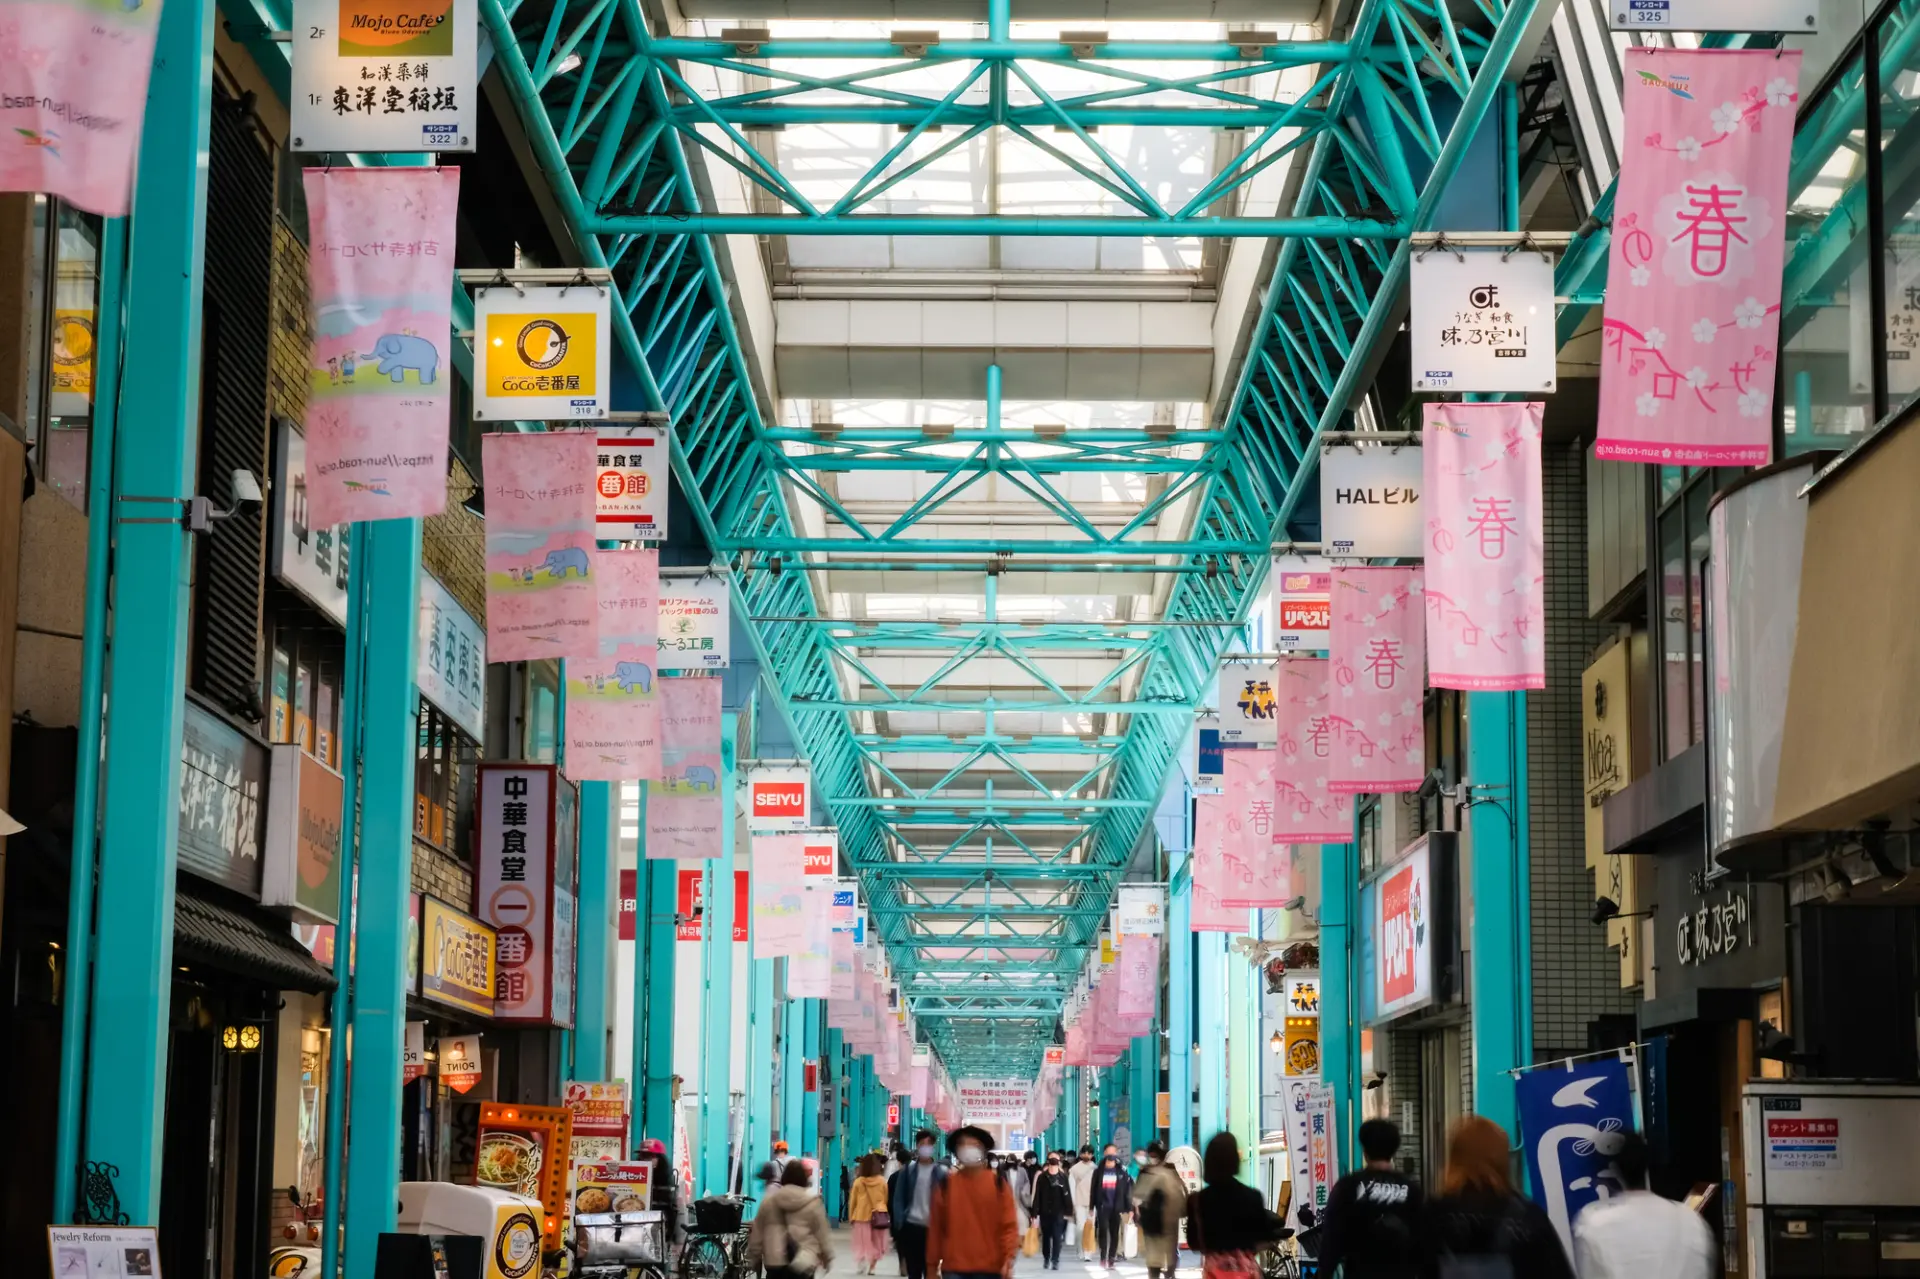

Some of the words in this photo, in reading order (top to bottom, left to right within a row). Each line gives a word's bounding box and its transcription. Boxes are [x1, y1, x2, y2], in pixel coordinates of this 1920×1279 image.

[351, 14, 393, 31] Mojo
[396, 14, 439, 28] Café
[1638, 11, 1662, 22] 325
[309, 26, 327, 39] 2F
[308, 93, 323, 106] 1F
[332, 84, 459, 116] 東洋堂稲垣
[429, 134, 451, 144] 322
[1455, 311, 1483, 324] うなぎ
[1490, 311, 1514, 324] 和食
[1441, 326, 1528, 347] 味乃宮川
[502, 375, 580, 391] CoCo壱番屋
[1431, 378, 1448, 386] 319
[1245, 680, 1272, 695] 天丼
[1237, 699, 1279, 719] てんや
[755, 793, 802, 806] SEIYU
[500, 776, 528, 882] 中華食堂
[1290, 1044, 1317, 1065] 500
[1770, 1122, 1836, 1133] テナント募集中
[53, 1232, 81, 1243] Jewelry
[83, 1232, 112, 1242] Reform
